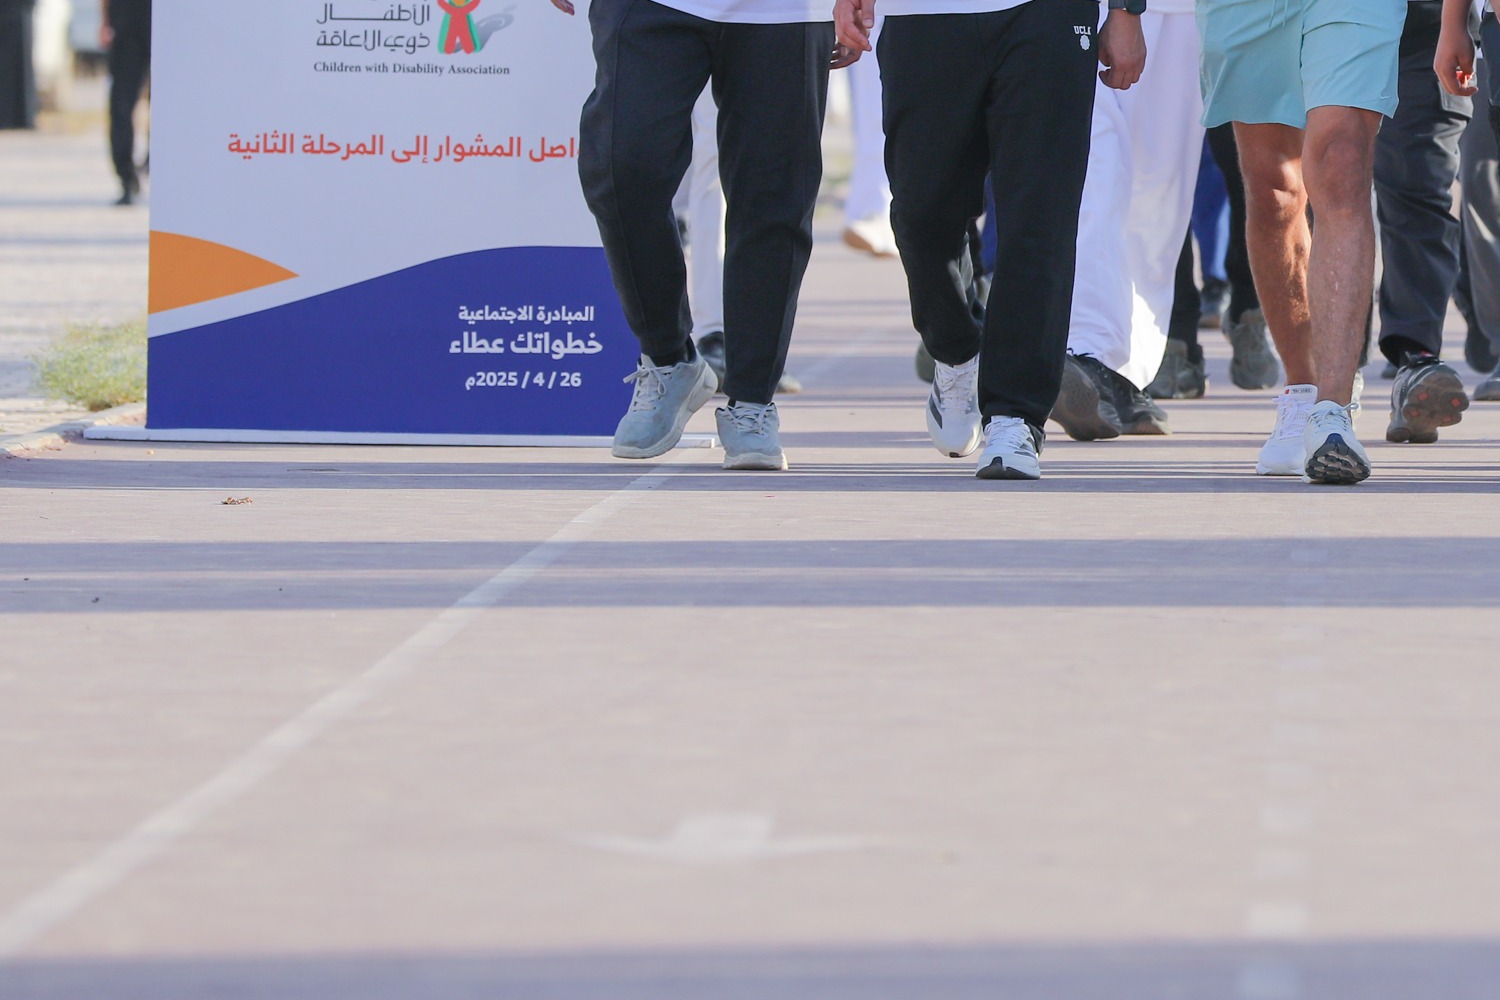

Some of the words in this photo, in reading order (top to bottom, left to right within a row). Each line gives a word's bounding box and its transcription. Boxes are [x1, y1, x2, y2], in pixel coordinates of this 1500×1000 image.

[313, 61, 362, 73] Children
[365, 62, 389, 73] with
[392, 63, 444, 76] Disability
[448, 64, 511, 75] Association
[227, 129, 295, 160] الثانية
[301, 133, 384, 161] المرحلة
[390, 135, 428, 164] إلى
[433, 133, 522, 163] المشوار
[528, 136, 580, 163] اصل
[458, 305, 534, 325] الاجتماعية
[536, 305, 595, 325] المبادرة
[448, 331, 505, 354] عطاء
[509, 331, 604, 360] خطواتك
[532, 371, 546, 388] 4
[559, 371, 582, 388] 26
